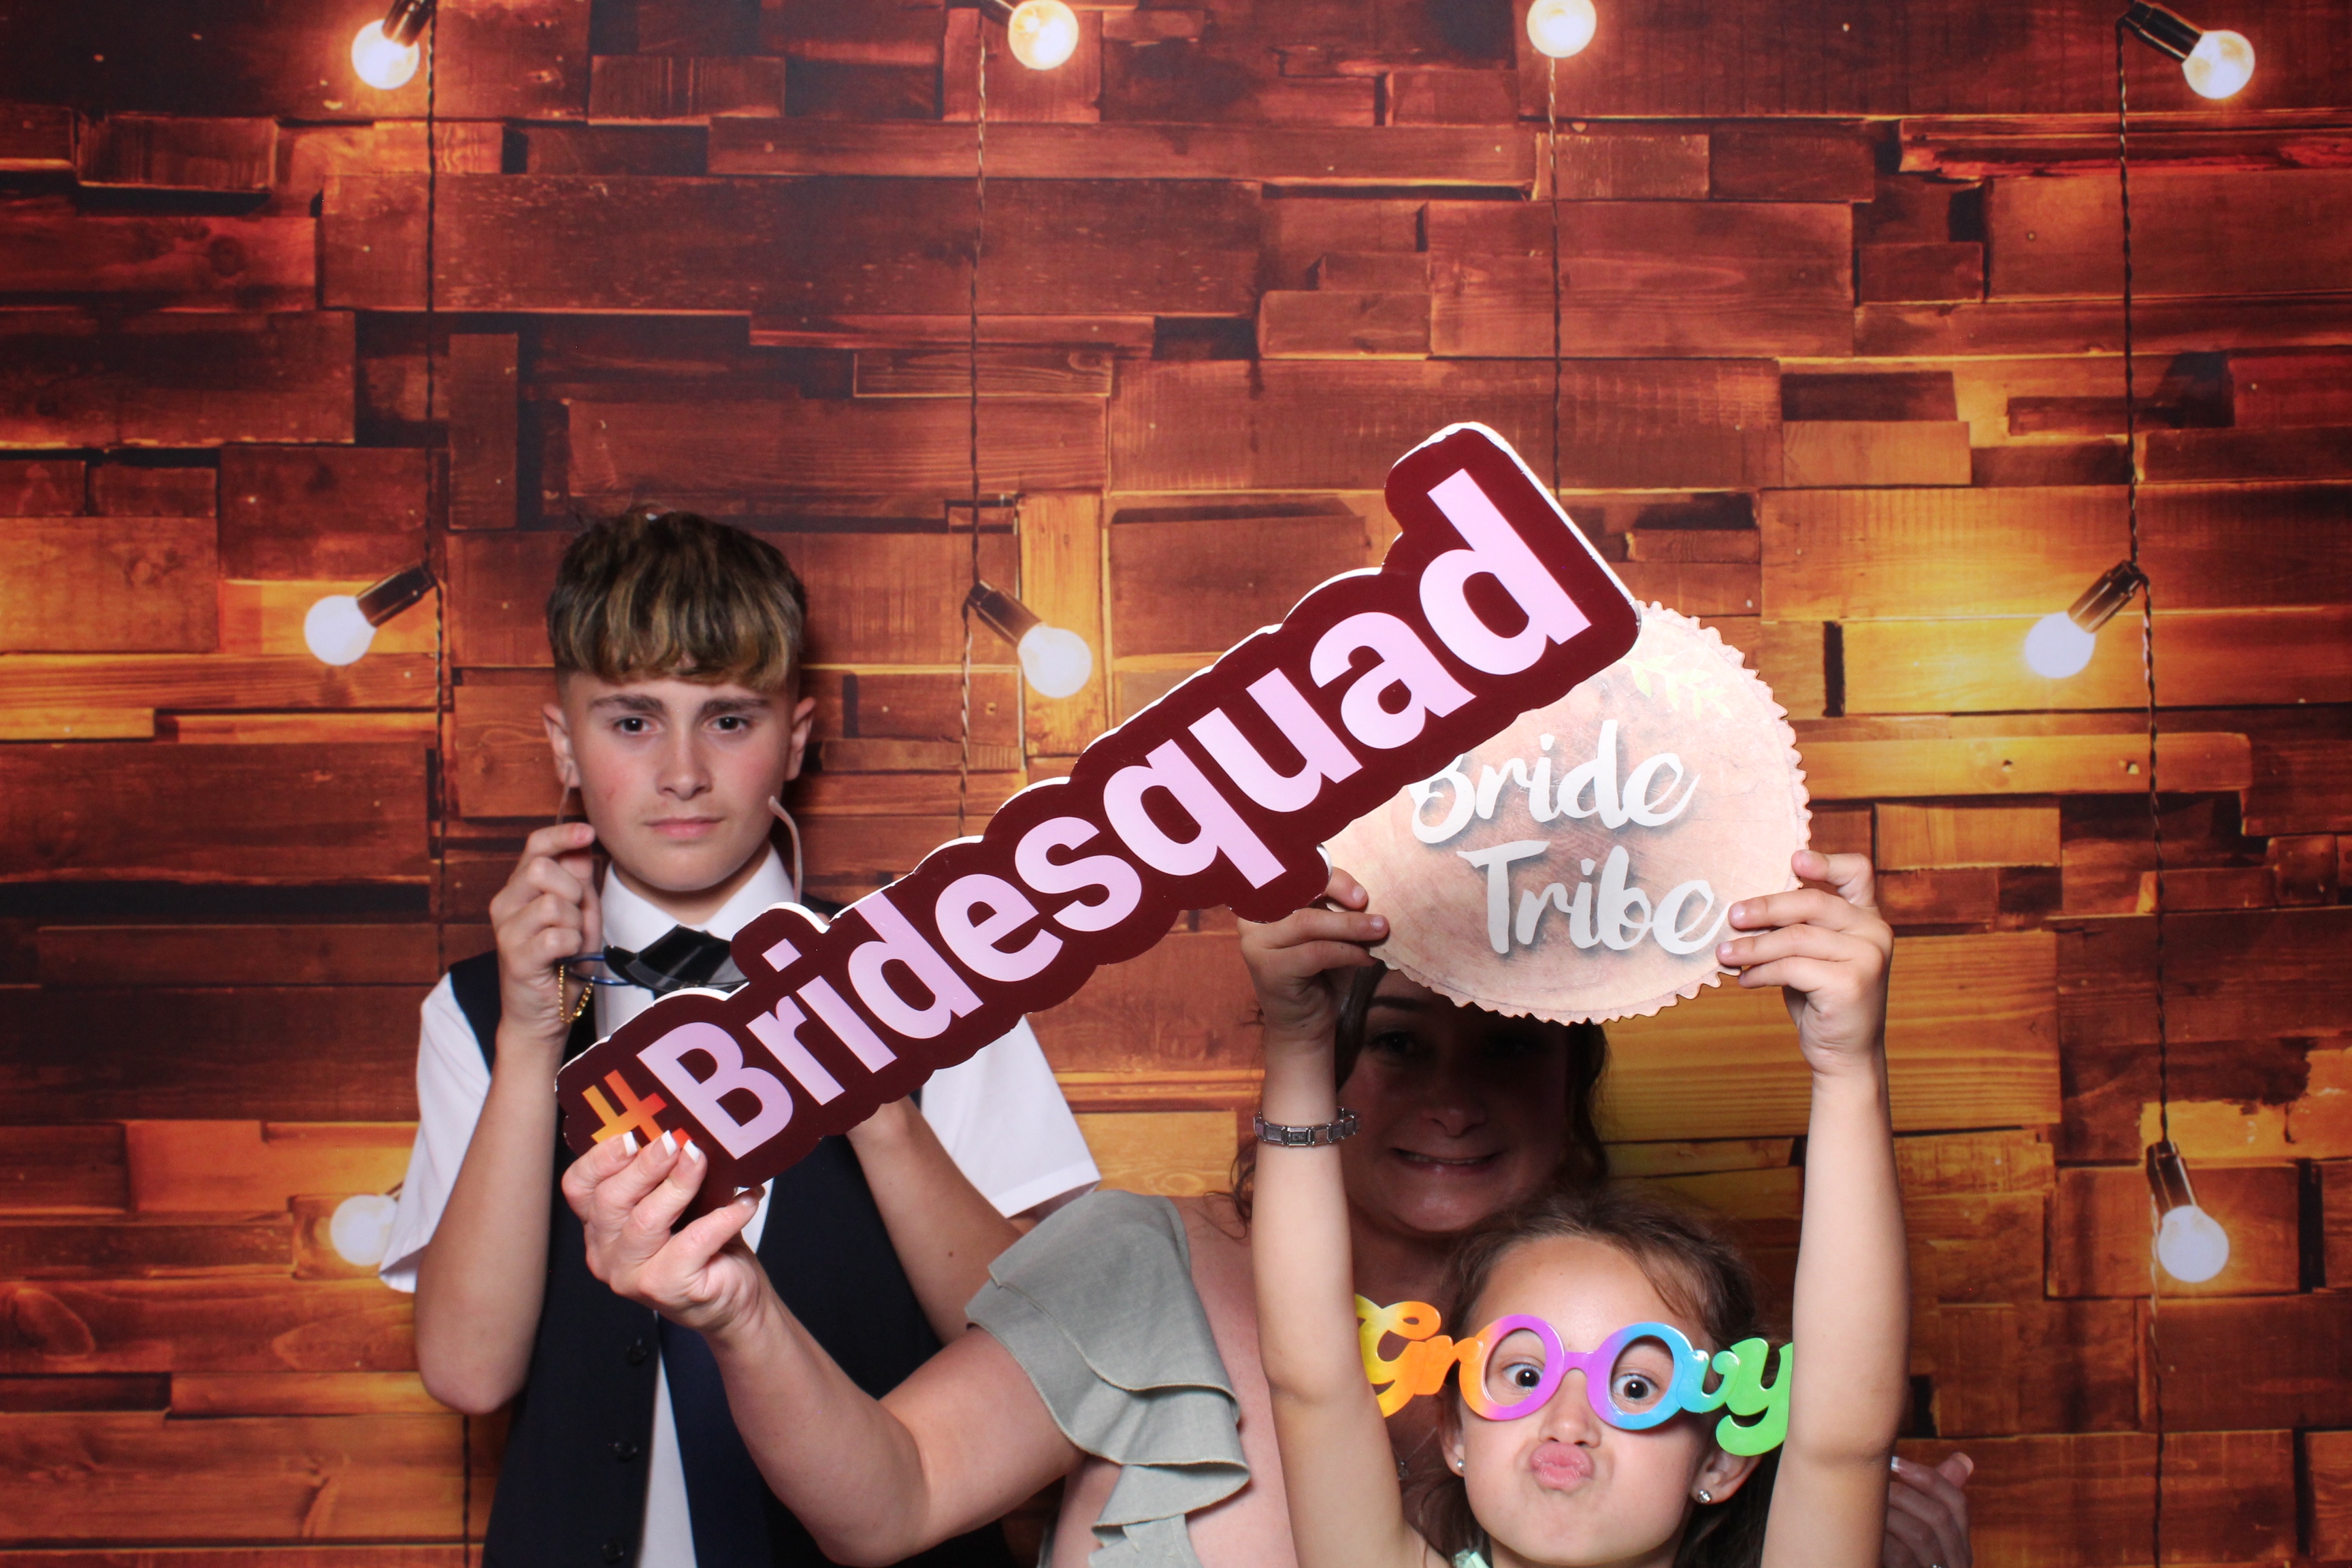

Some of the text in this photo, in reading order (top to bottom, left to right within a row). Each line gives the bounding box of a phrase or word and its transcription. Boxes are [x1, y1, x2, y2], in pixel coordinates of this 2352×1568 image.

[582, 470, 1590, 1160] #Bridesquad
[1407, 719, 1701, 843] Bride
[1457, 840, 1732, 954] Tribe
